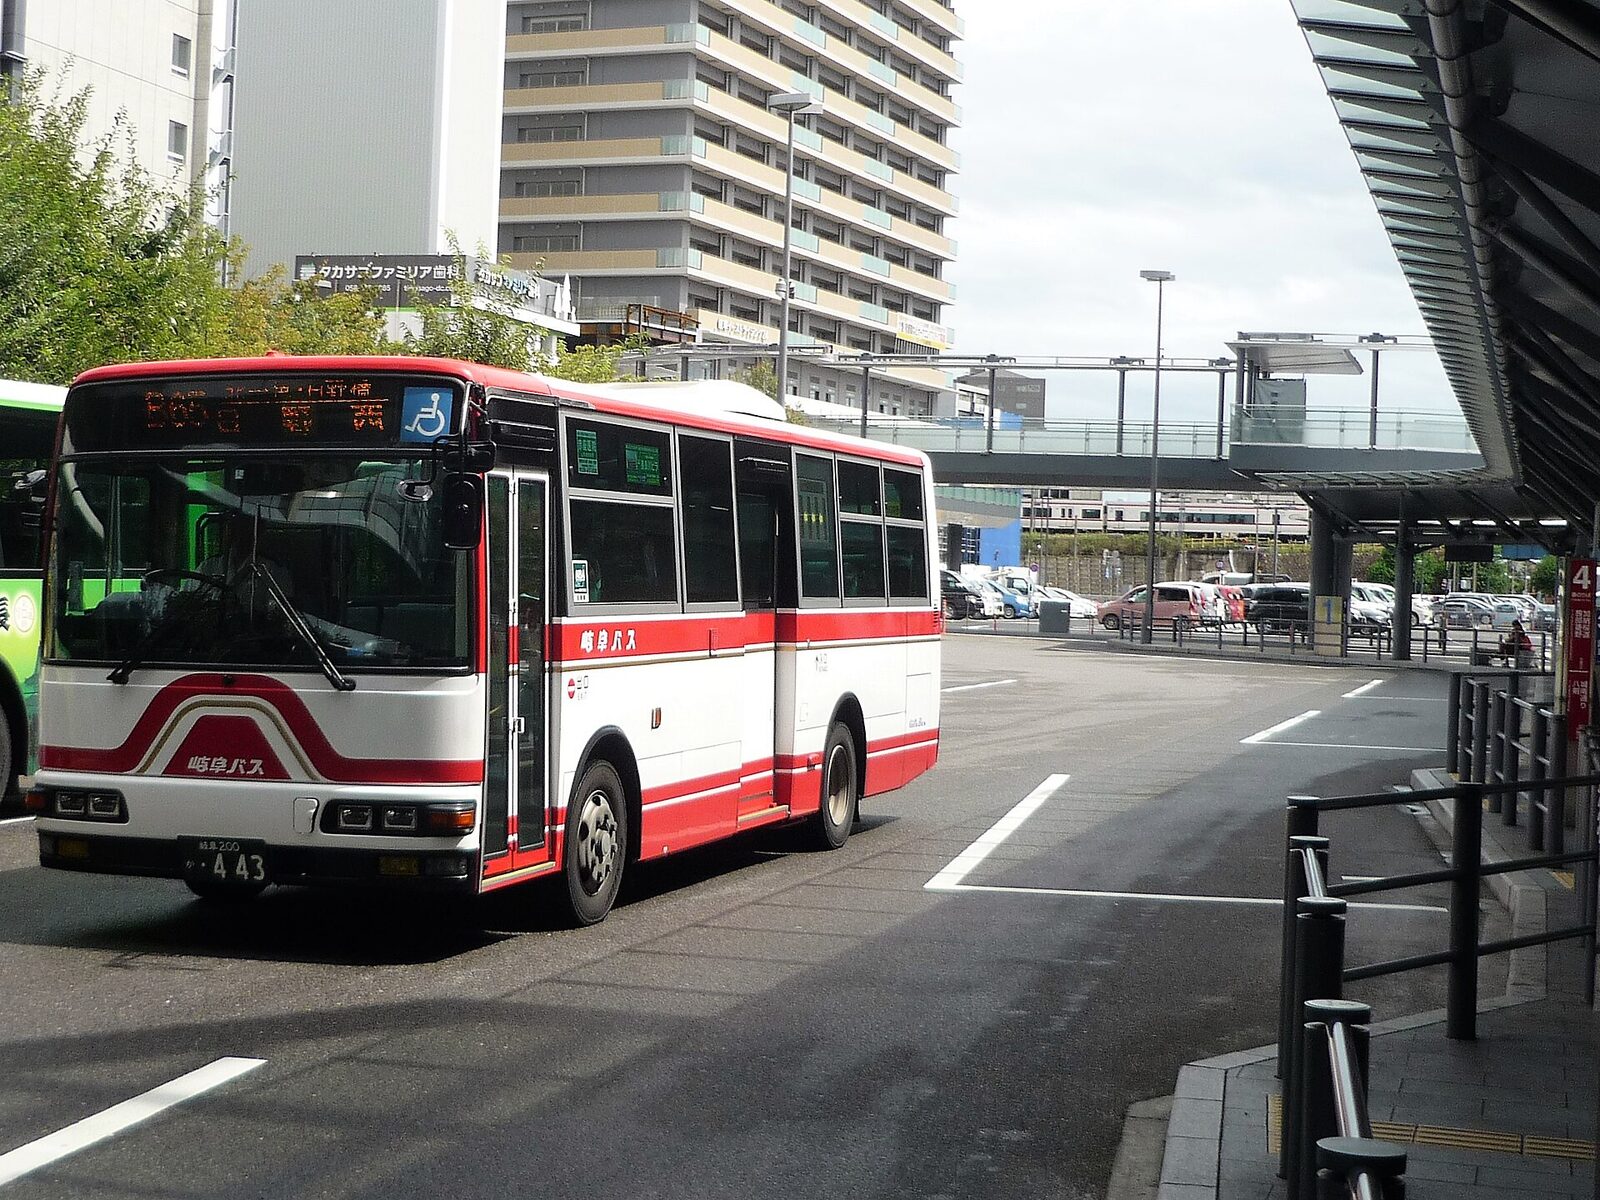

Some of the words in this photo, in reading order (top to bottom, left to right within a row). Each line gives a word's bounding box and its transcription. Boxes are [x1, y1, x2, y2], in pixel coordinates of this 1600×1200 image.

[1572, 565, 1591, 590] 4
[1322, 600, 1333, 625] 1
[580, 629, 636, 653] 岐阜バス
[187, 755, 264, 775] 岐阜バス
